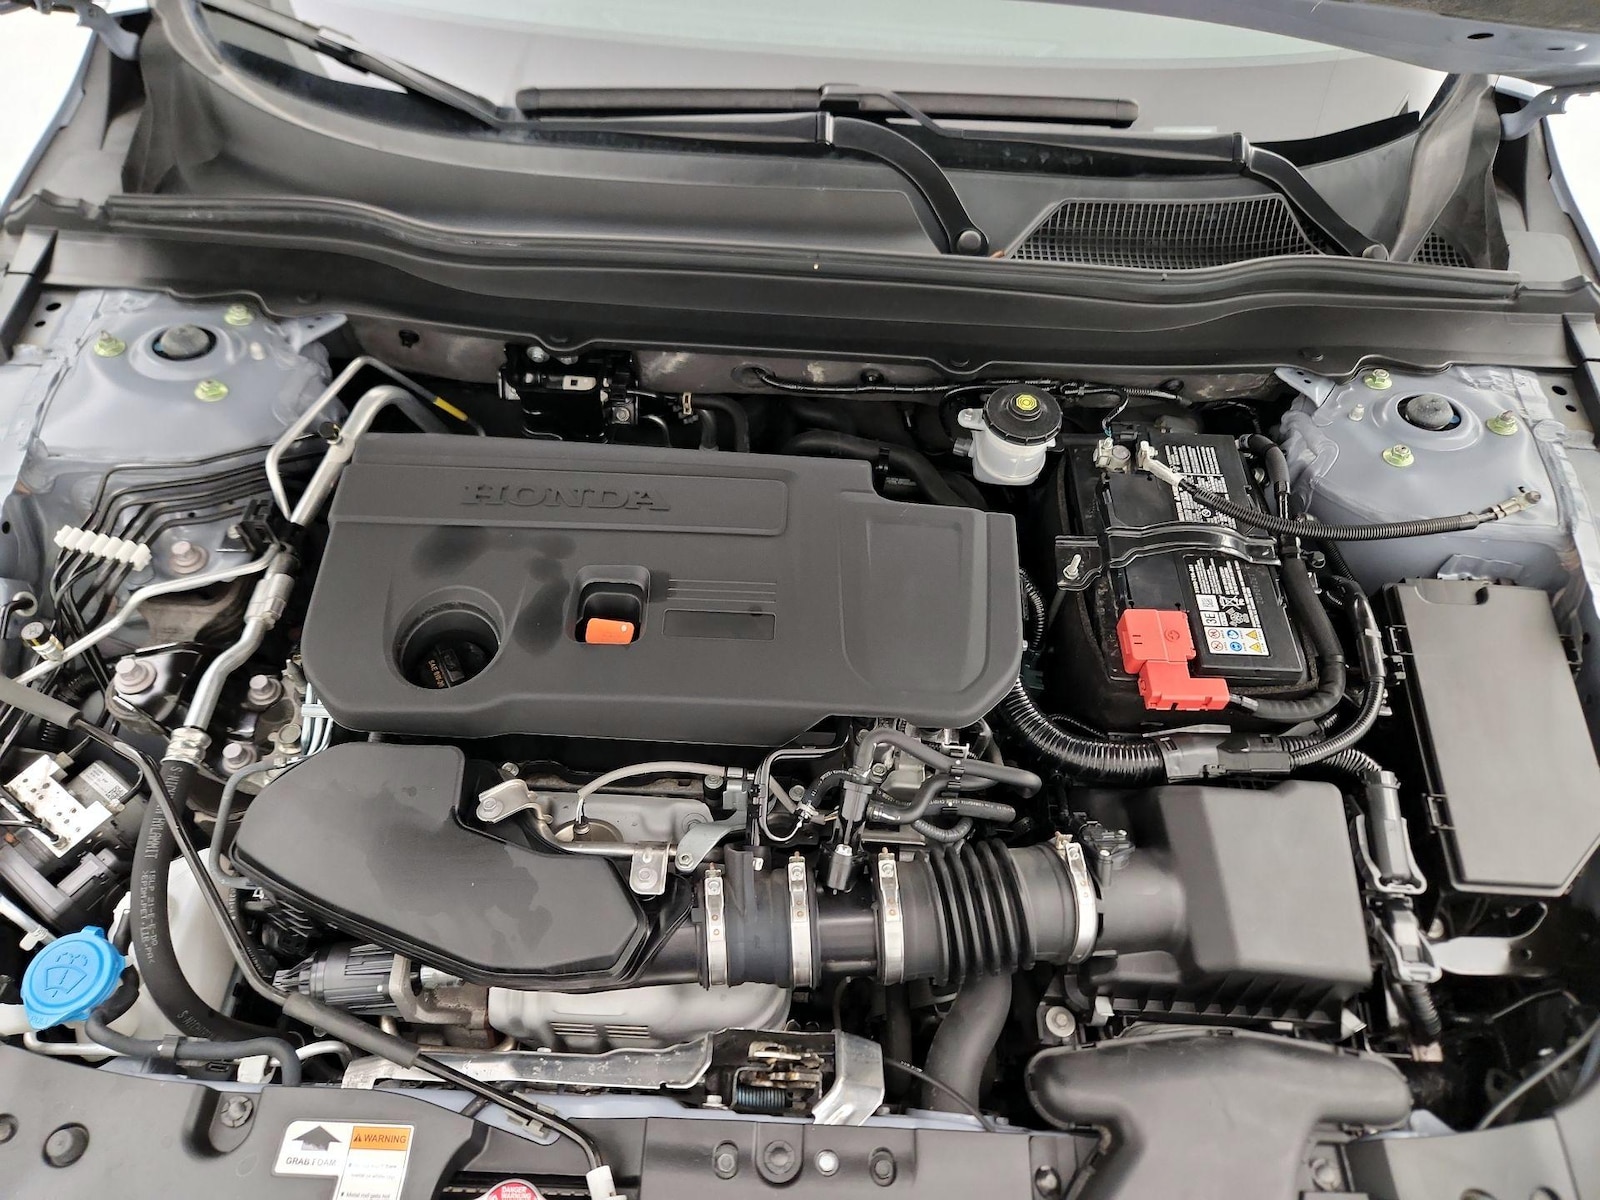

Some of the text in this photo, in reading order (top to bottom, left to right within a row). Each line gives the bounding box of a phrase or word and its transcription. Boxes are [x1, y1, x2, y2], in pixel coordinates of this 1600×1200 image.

[461, 484, 670, 511] HONDA
[1204, 613, 1218, 624] 3E
[428, 659, 438, 672] SAE
[364, 1134, 407, 1144] WARNING
[286, 1156, 310, 1166] GRAB
